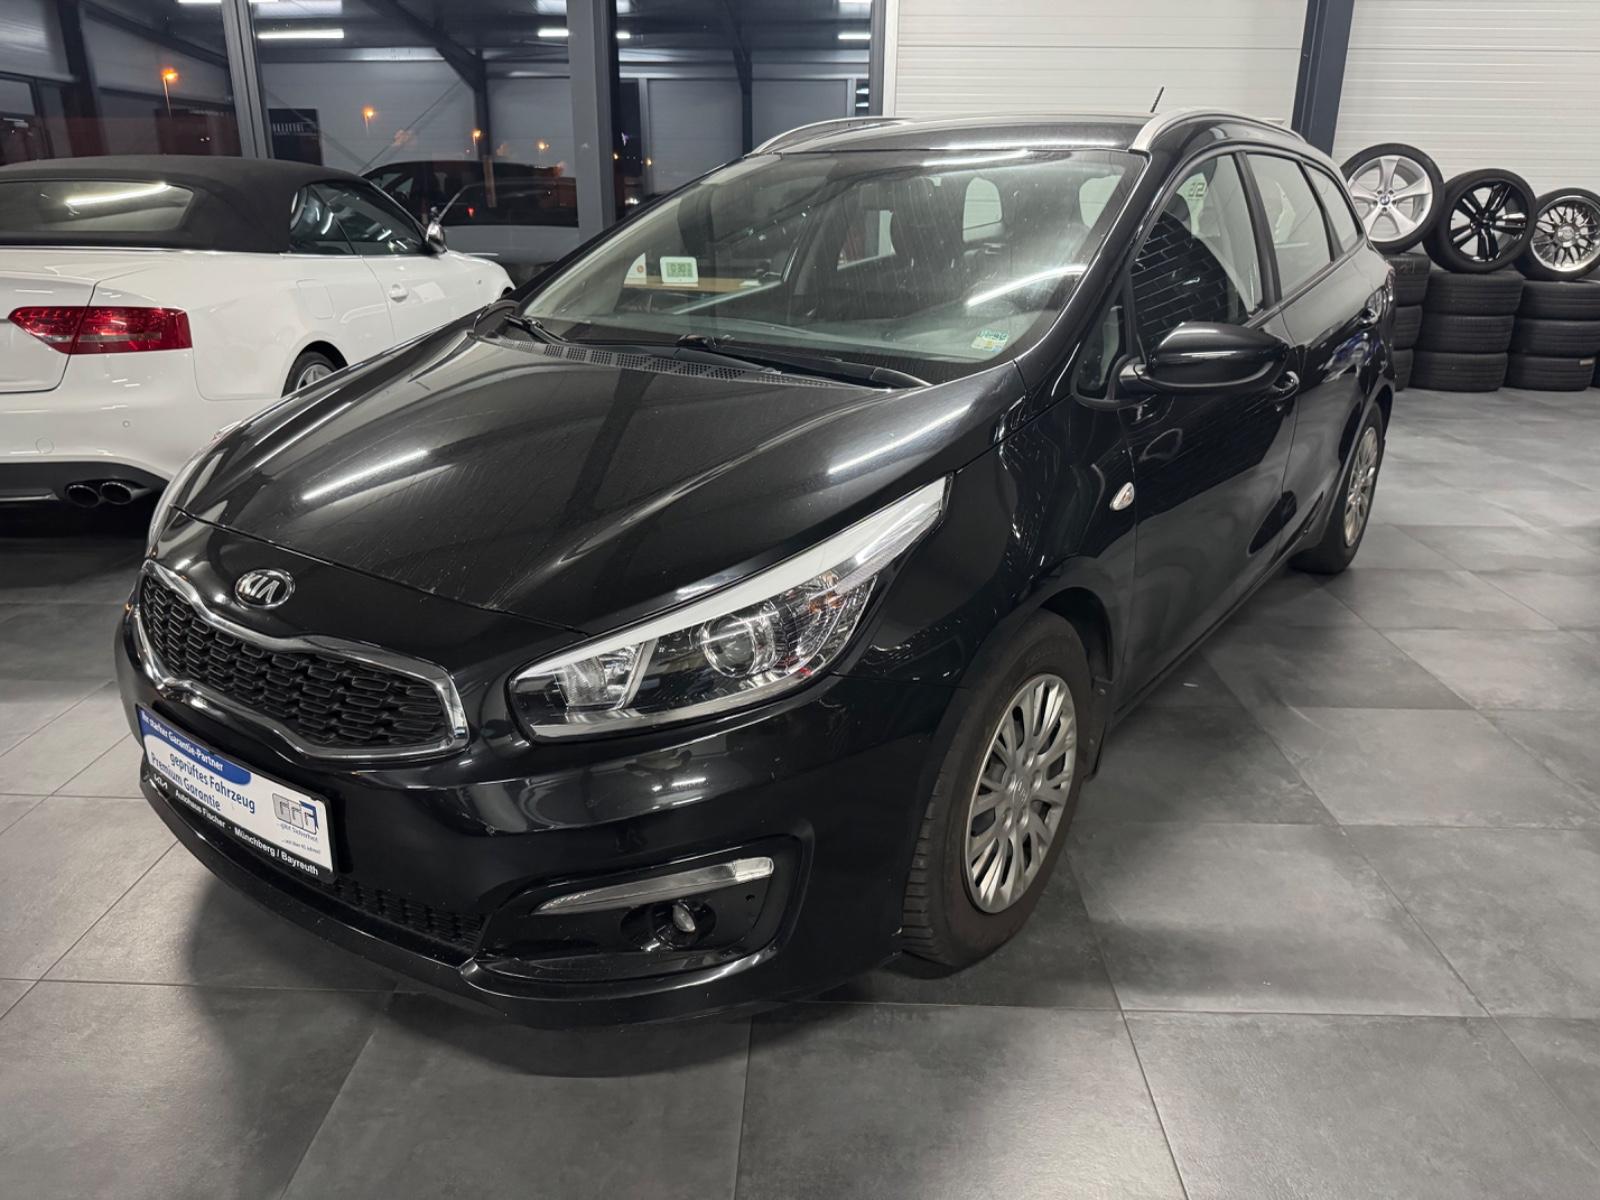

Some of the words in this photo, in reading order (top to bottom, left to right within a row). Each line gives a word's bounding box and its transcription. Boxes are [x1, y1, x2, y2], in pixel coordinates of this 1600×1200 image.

[151, 752, 183, 787] Premium
[184, 778, 221, 811] Garantie
[170, 753, 208, 786] geprüftes
[209, 775, 255, 814] Fahrzeug
[175, 790, 202, 813] Autohaus
[202, 808, 226, 828] Fischer
[234, 827, 275, 857] Münchberg
[281, 851, 319, 876] Bayreuth
